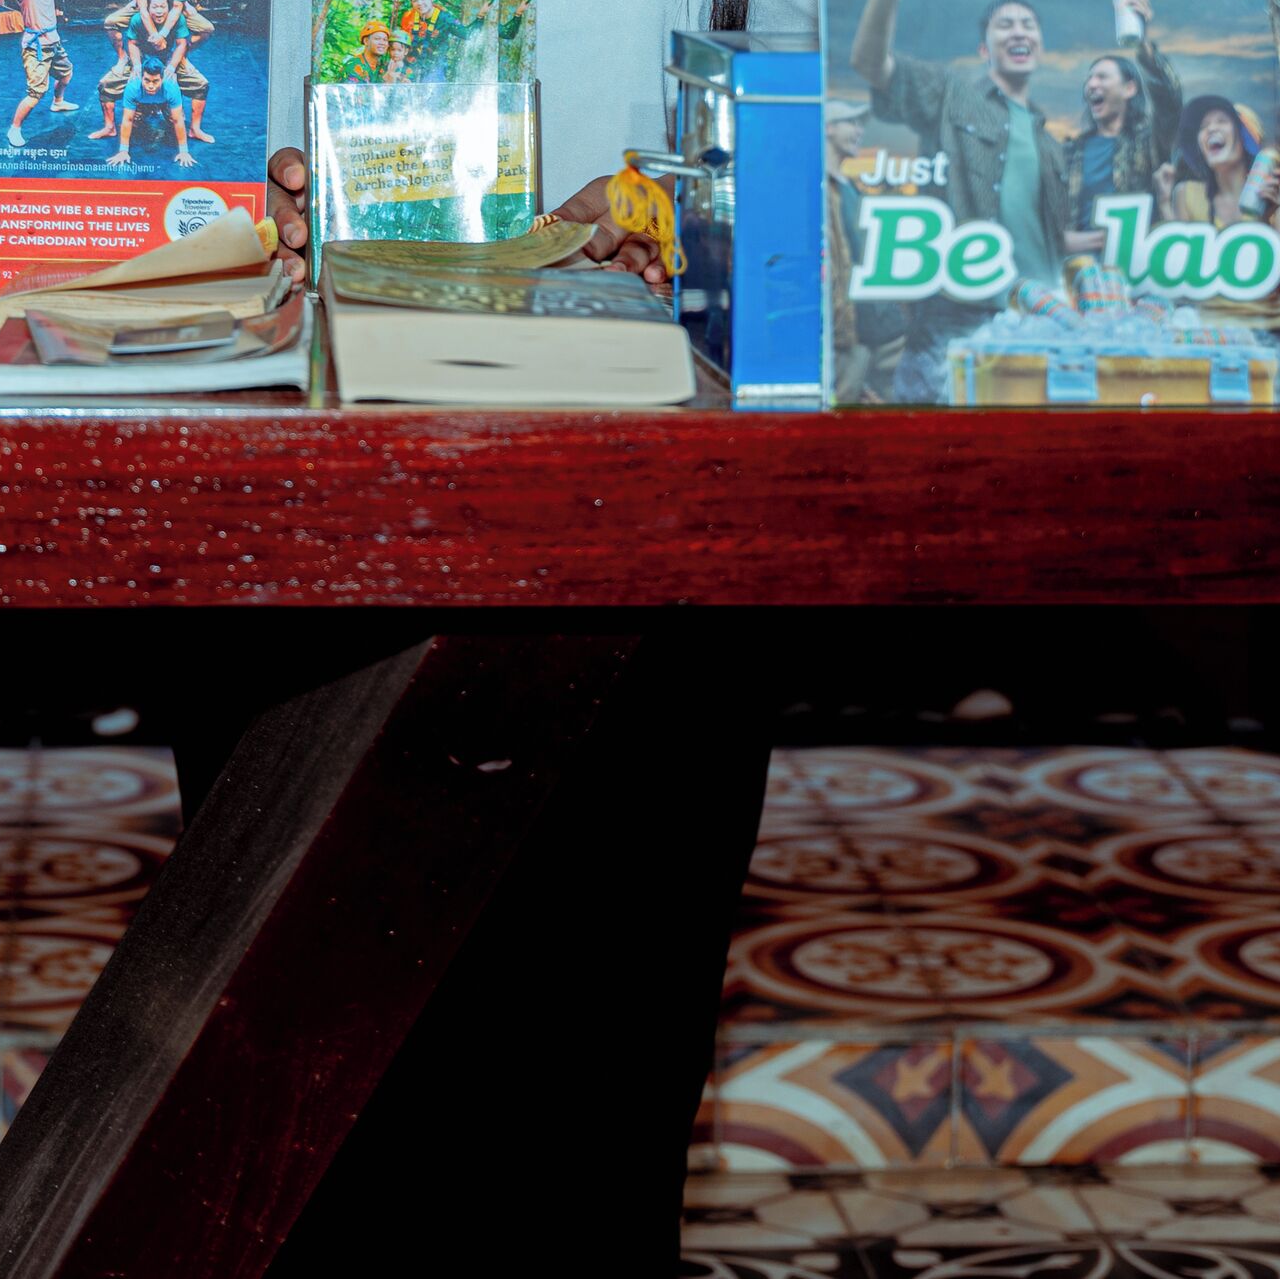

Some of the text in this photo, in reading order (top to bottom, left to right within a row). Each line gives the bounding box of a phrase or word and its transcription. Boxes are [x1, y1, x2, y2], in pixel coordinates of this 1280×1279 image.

[860, 150, 949, 186] Just
[54, 204, 82, 216] VIBE
[84, 205, 94, 216] &
[96, 205, 150, 219] ENERGY,
[88, 221, 113, 232] THE
[115, 221, 150, 233] LIVES
[8, 235, 87, 247] CAMBODIAN
[855, 199, 1011, 294] Be
